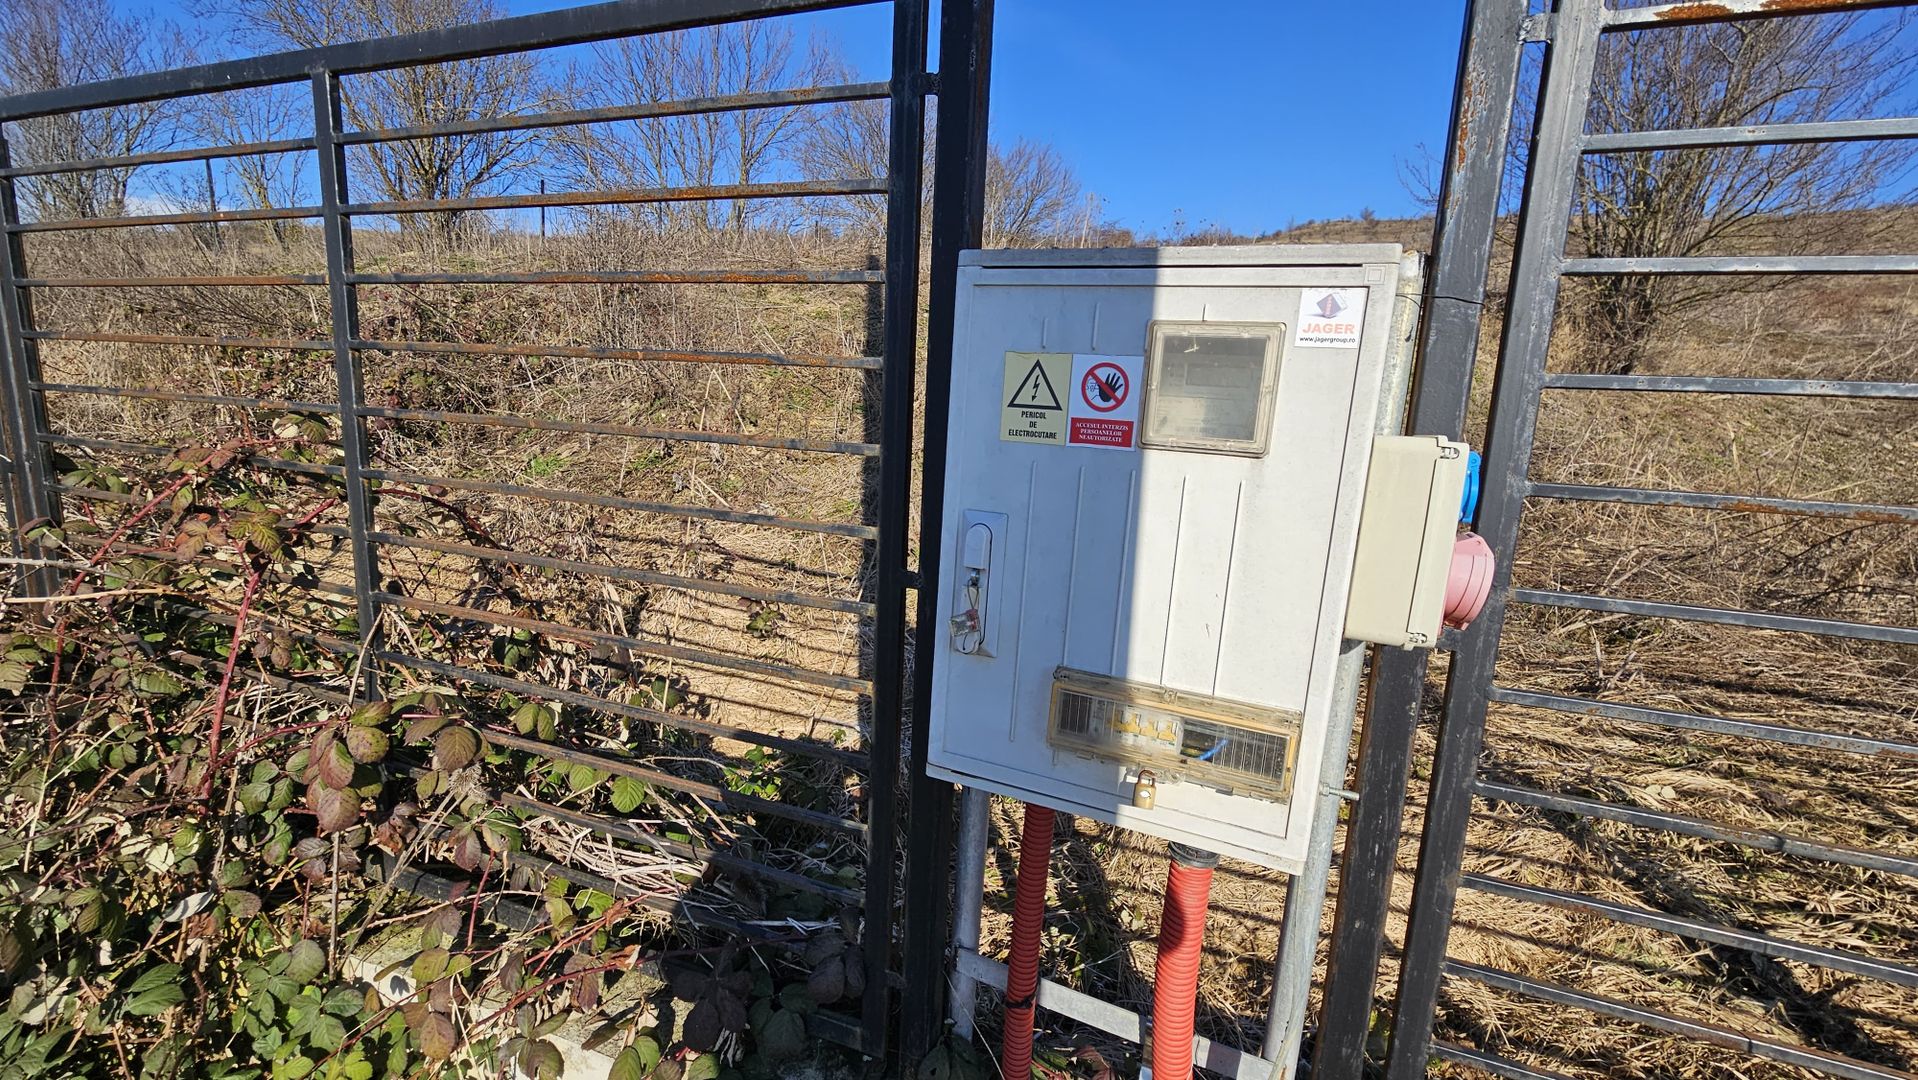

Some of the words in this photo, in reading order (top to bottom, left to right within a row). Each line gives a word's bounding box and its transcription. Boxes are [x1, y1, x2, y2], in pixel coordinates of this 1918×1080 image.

[1302, 323, 1355, 334] JAGER
[1021, 410, 1046, 419] PERICOL
[1008, 430, 1056, 439] ELECTROCUTARE
[1080, 428, 1122, 436] PERSOANELOR
[1079, 434, 1122, 442] NEAUTORIZATE
